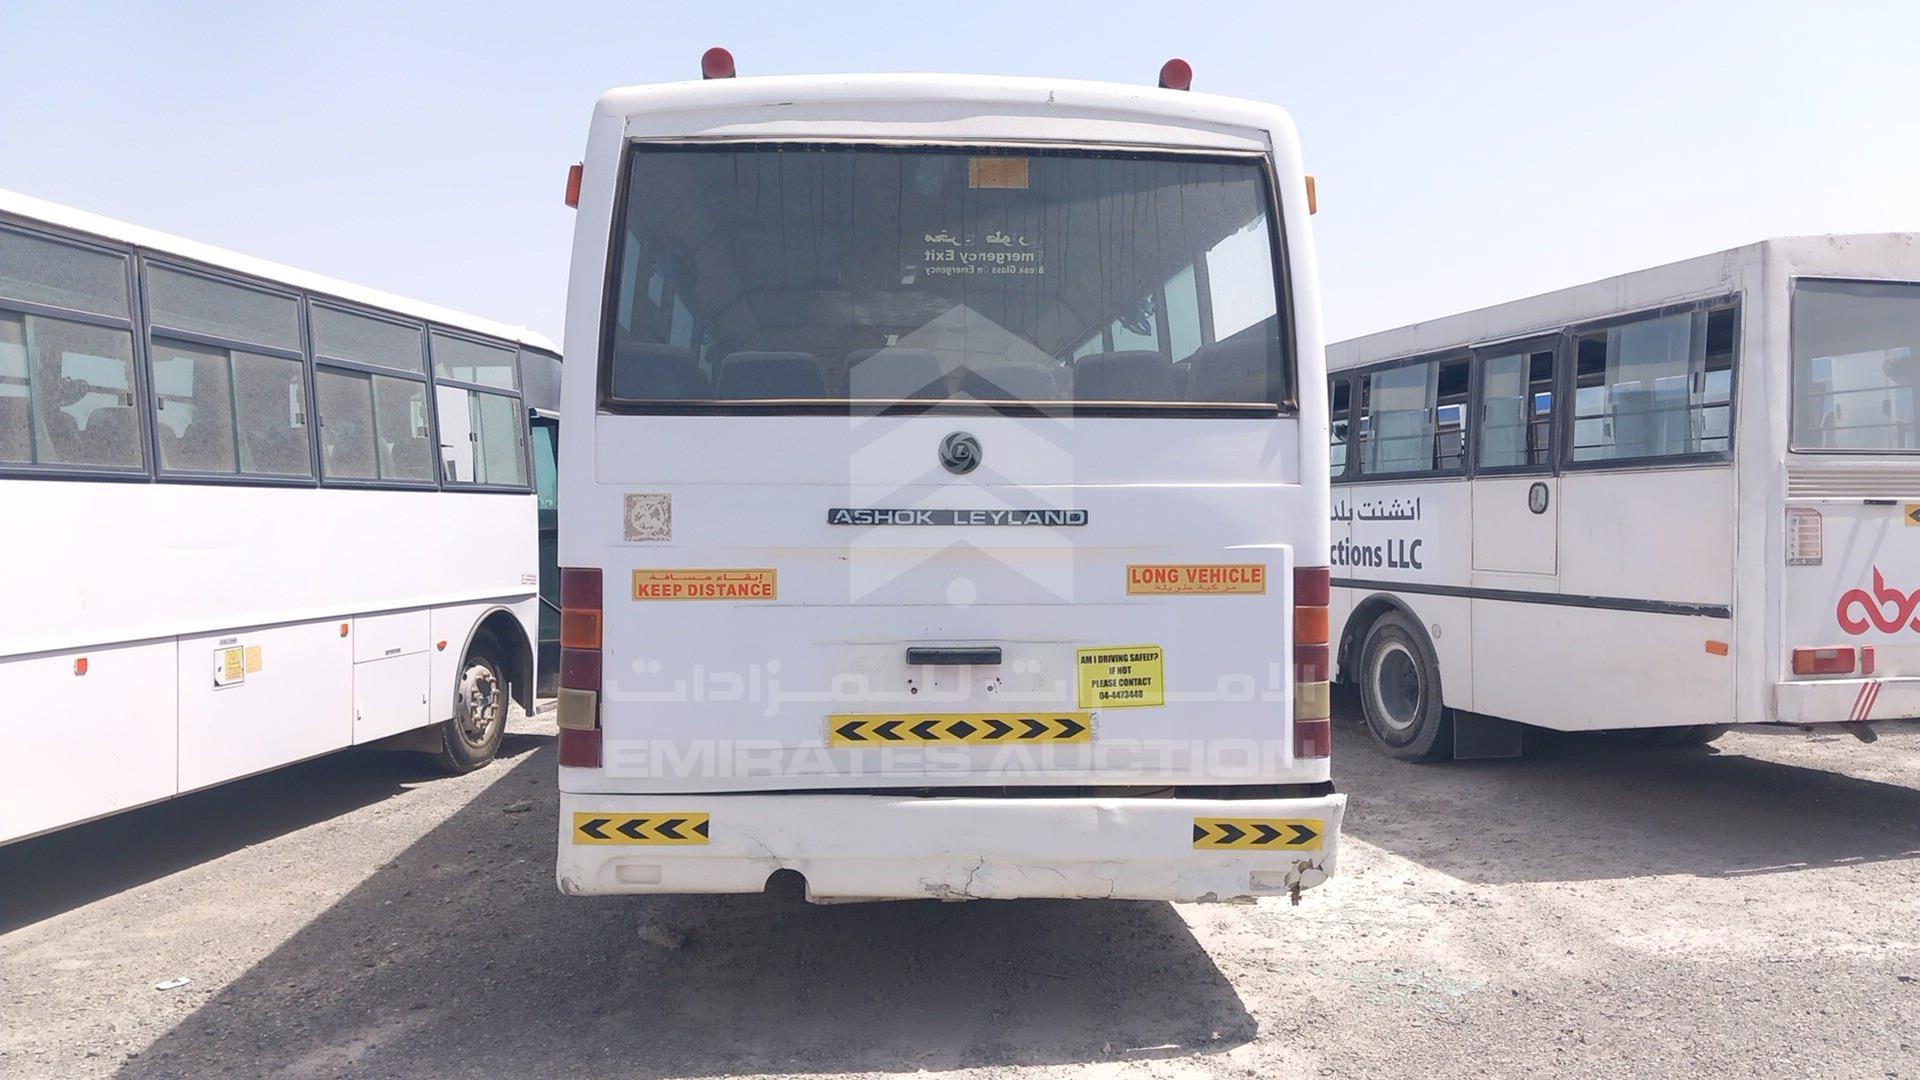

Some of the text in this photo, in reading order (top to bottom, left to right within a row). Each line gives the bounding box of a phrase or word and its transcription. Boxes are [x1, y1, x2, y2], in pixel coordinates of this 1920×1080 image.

[832, 509, 1086, 526] ASHOK LEYLAND
[1387, 539, 1423, 570] LLC
[1131, 568, 1261, 584] LONG VEHICLE
[638, 583, 772, 597] KEEP DISTANCE
[1080, 655, 1092, 664] AM
[1098, 654, 1128, 664] DRIVING
[1129, 652, 1159, 662] SAFELY?
[1108, 666, 1132, 675] IF NOT
[1091, 677, 1151, 688] PLEASE CONTACT
